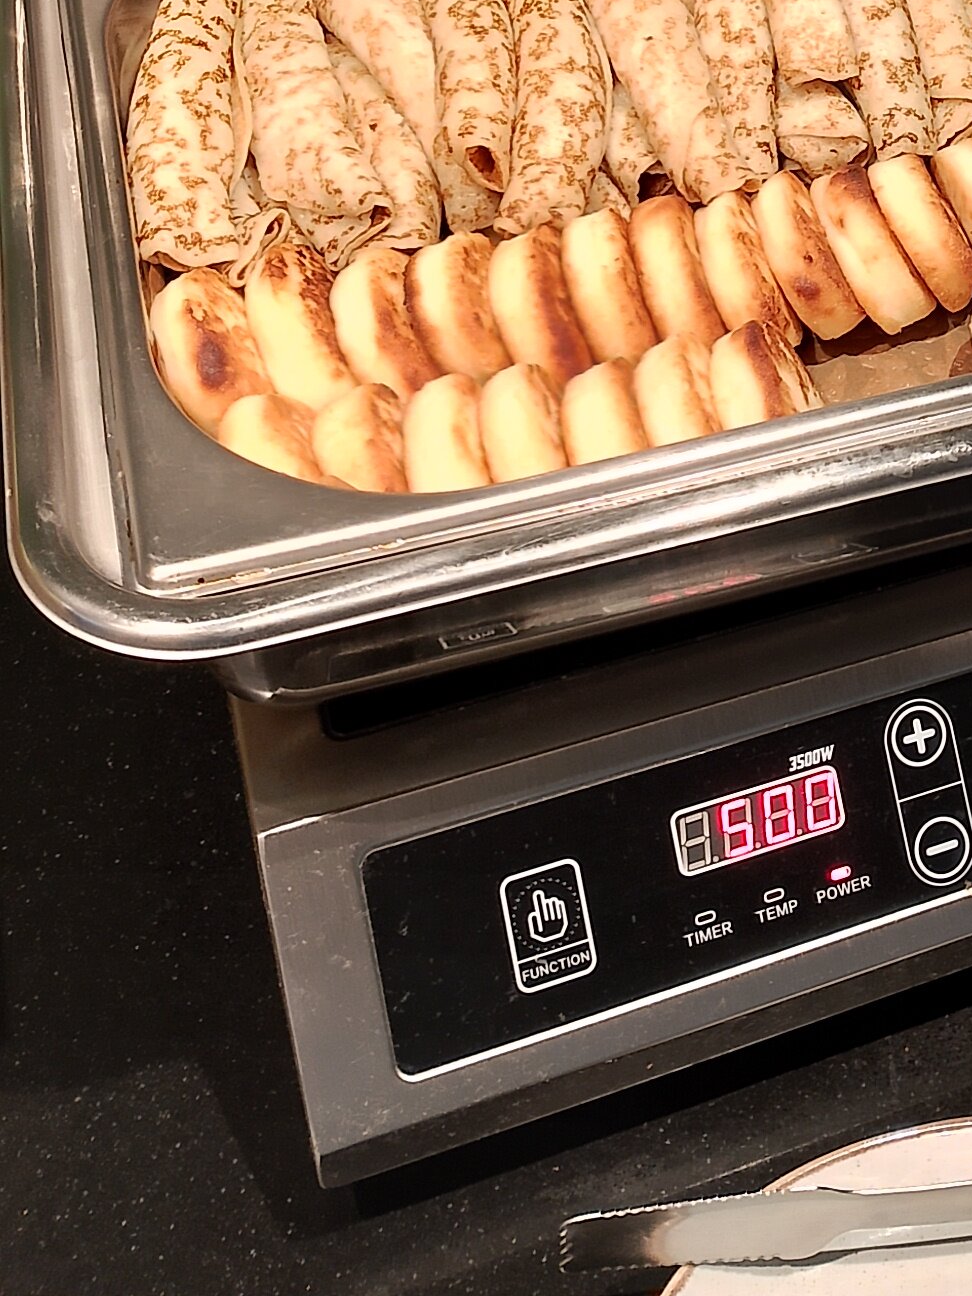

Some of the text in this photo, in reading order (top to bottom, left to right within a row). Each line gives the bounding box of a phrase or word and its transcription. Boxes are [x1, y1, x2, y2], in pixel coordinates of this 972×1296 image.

[788, 744, 835, 773] 3500W
[682, 875, 872, 948] TIMER TEMP POWER
[520, 949, 592, 983] FUNCTION
